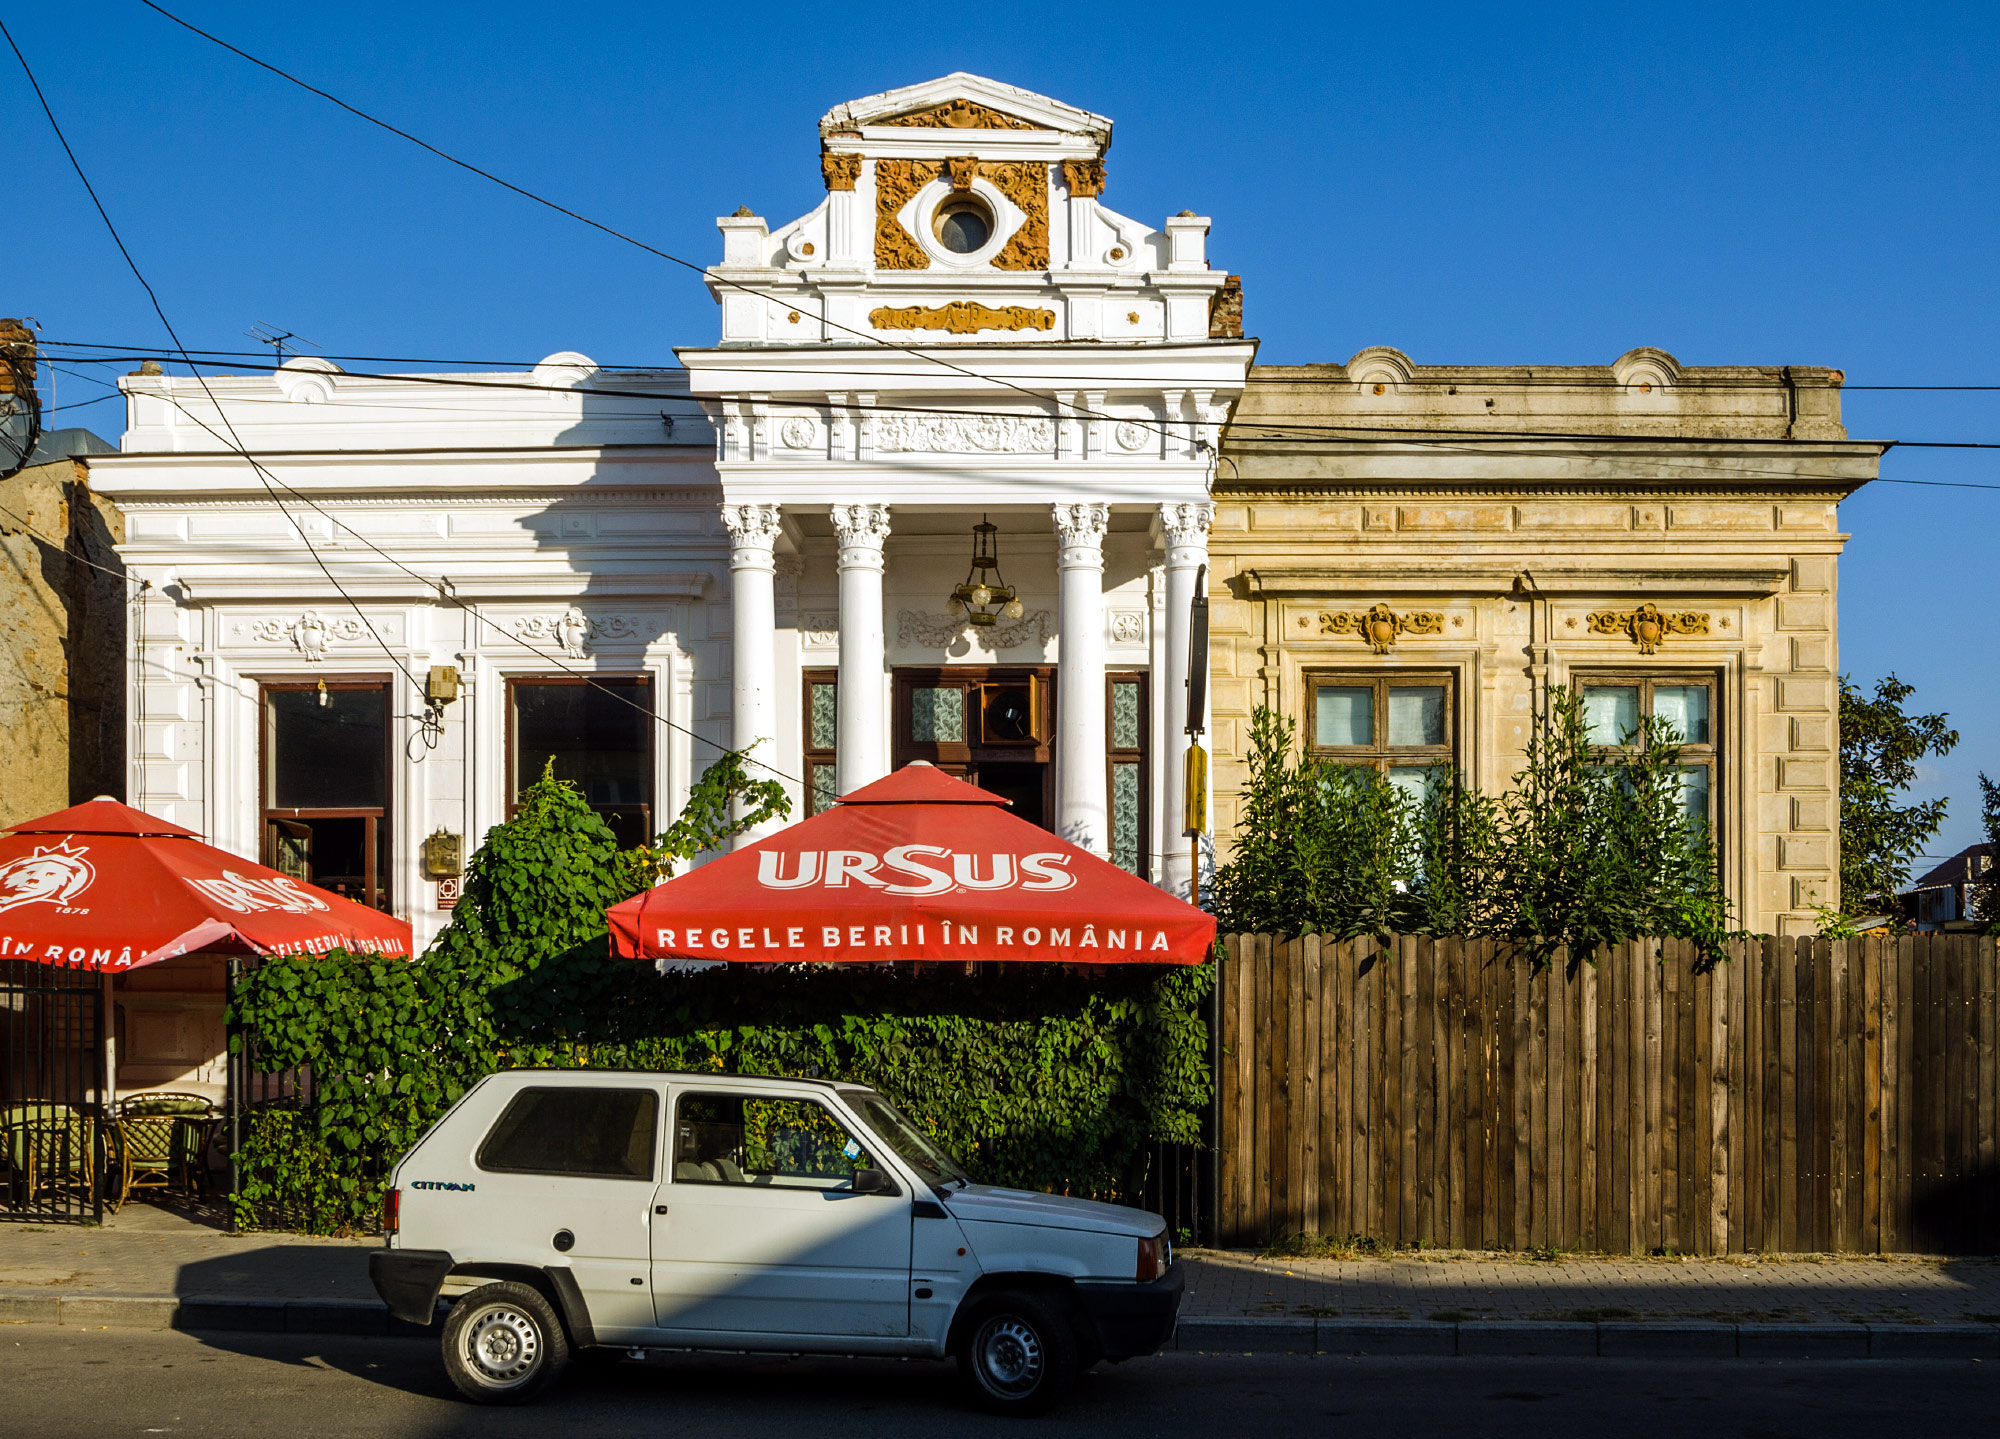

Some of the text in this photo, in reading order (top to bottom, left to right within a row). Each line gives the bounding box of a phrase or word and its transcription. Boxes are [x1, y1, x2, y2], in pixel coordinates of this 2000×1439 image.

[757, 844, 1078, 897] URSUS
[182, 869, 331, 915] URSUS
[55, 906, 91, 915] 1878
[1, 936, 34, 955] ÎN
[657, 920, 1169, 951] REGELE BERII ÎN ROMÂNIA
